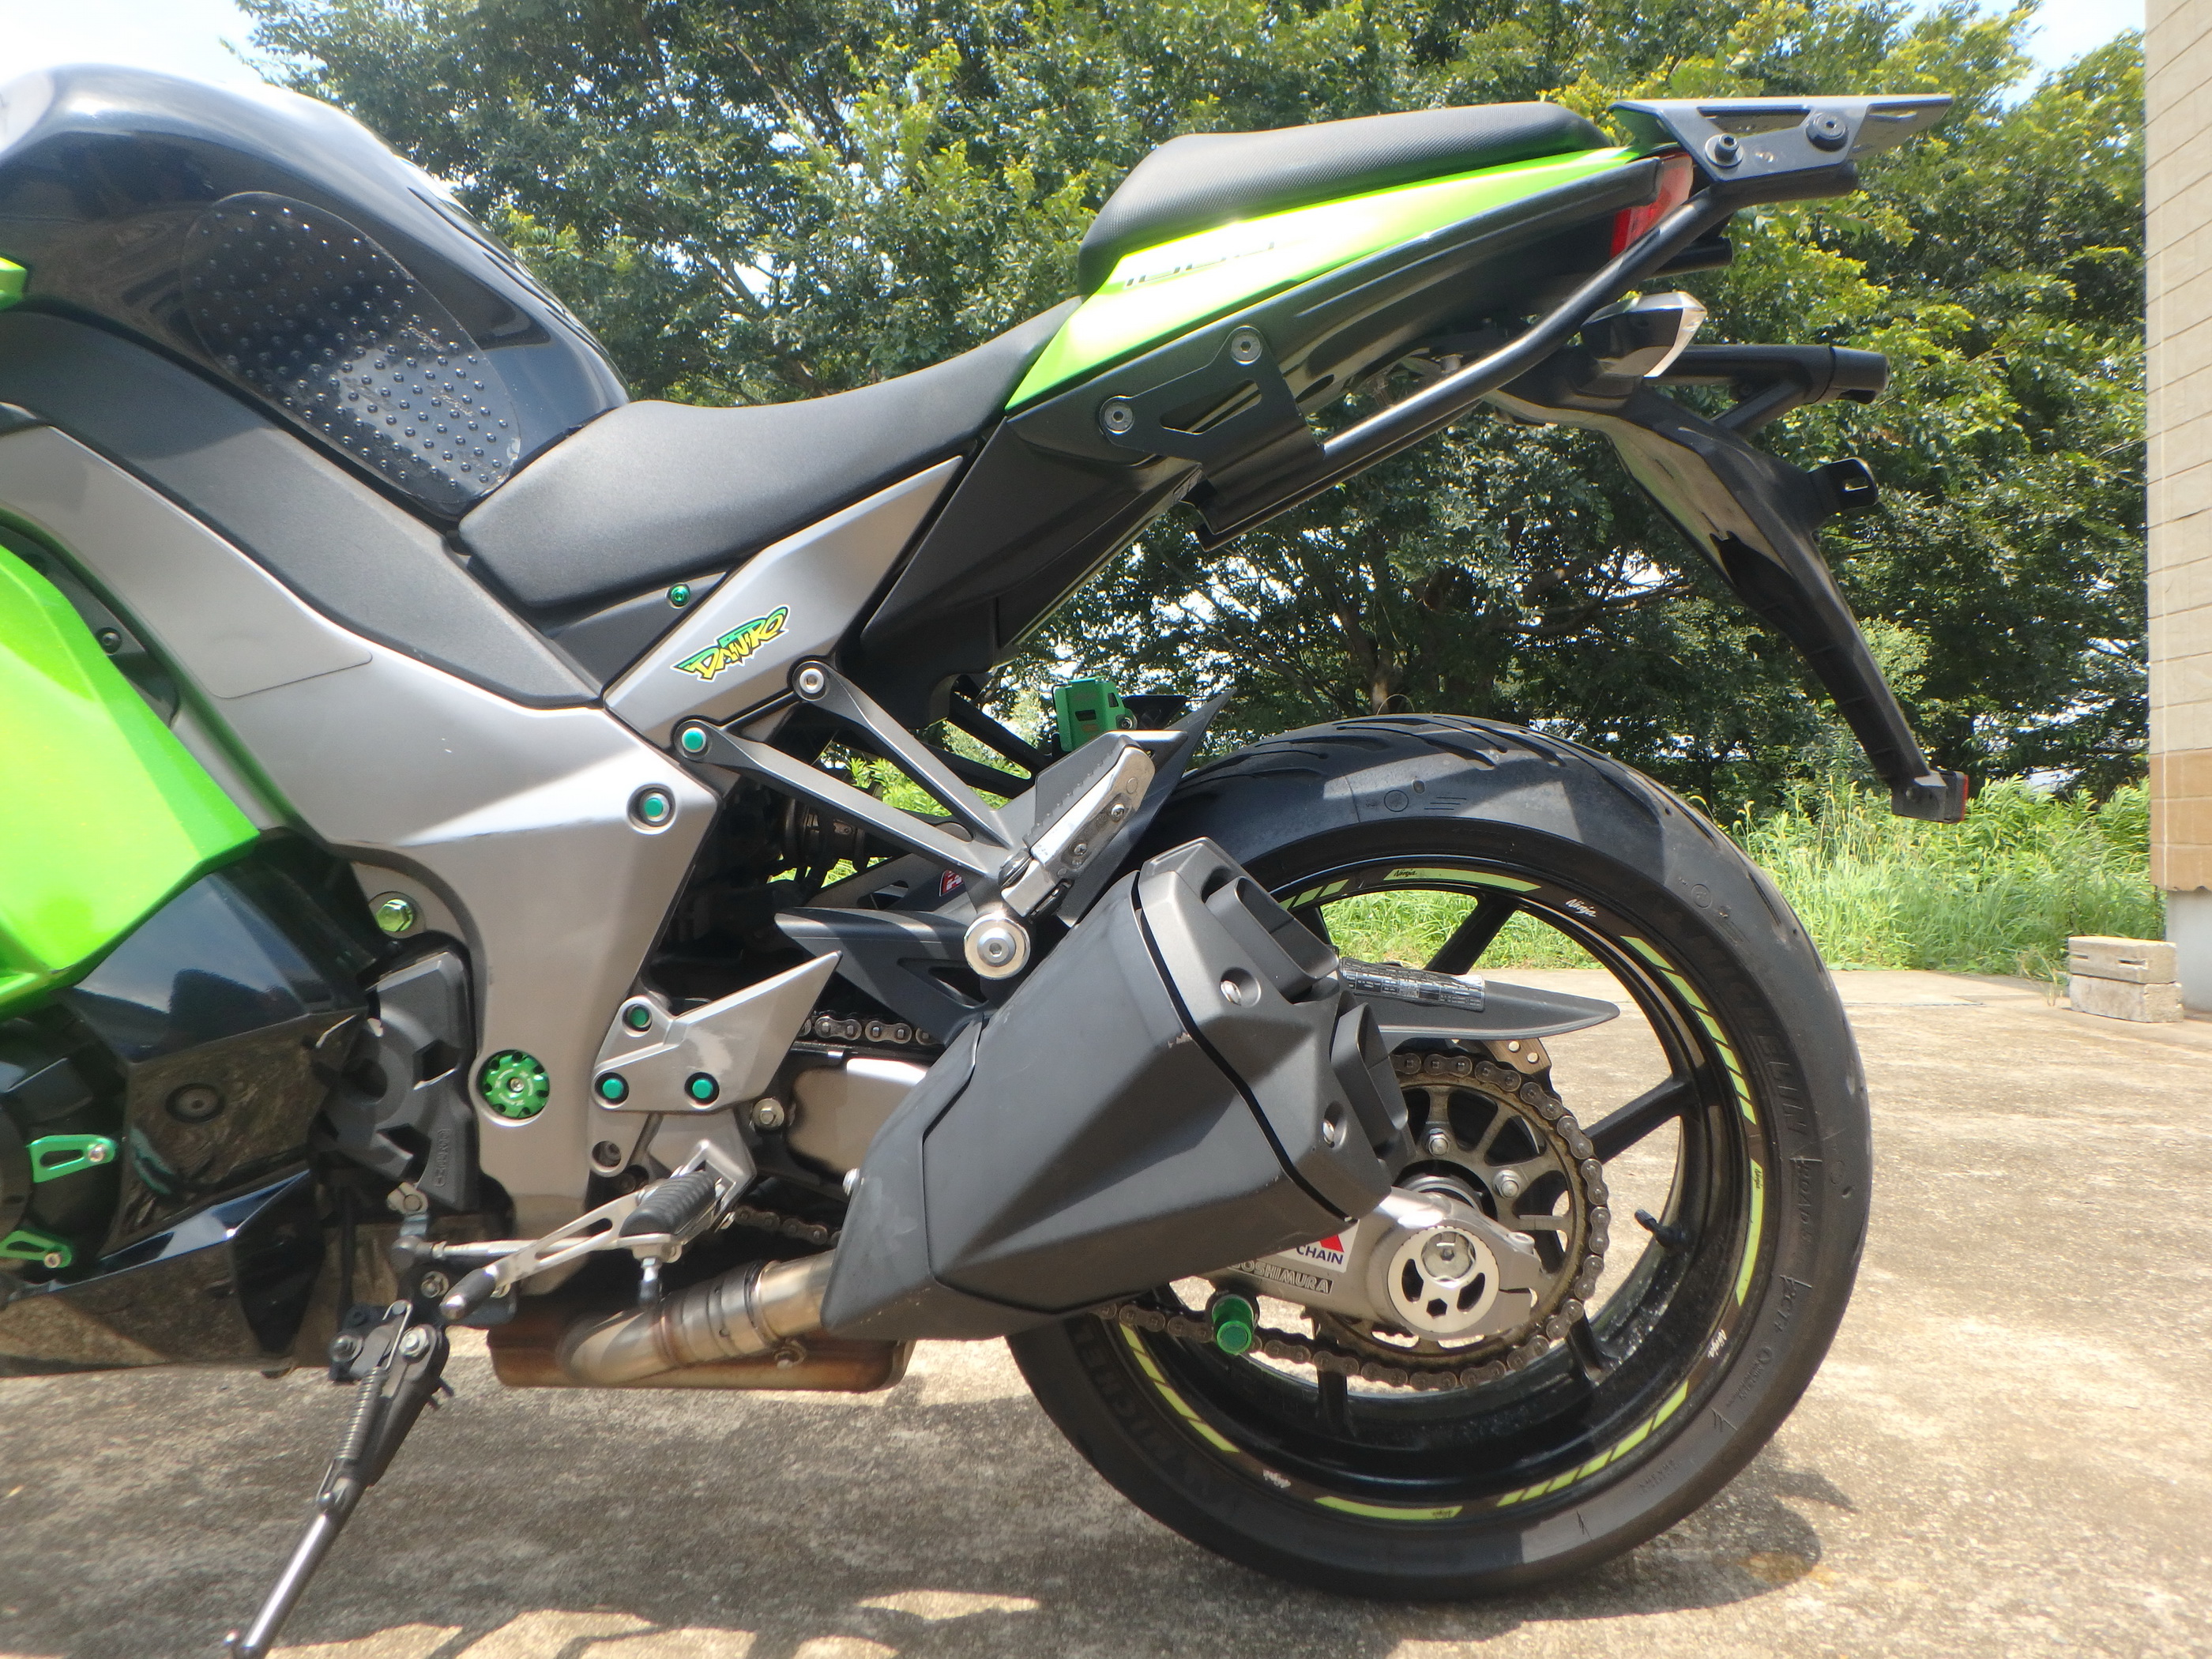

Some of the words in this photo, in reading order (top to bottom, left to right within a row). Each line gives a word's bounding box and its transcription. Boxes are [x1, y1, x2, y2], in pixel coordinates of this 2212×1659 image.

[1394, 868, 1417, 877] Ninja
[1565, 898, 1597, 917] Ninja
[1296, 1245, 1344, 1266] CHAIN
[1707, 1329, 1728, 1358] Ninja
